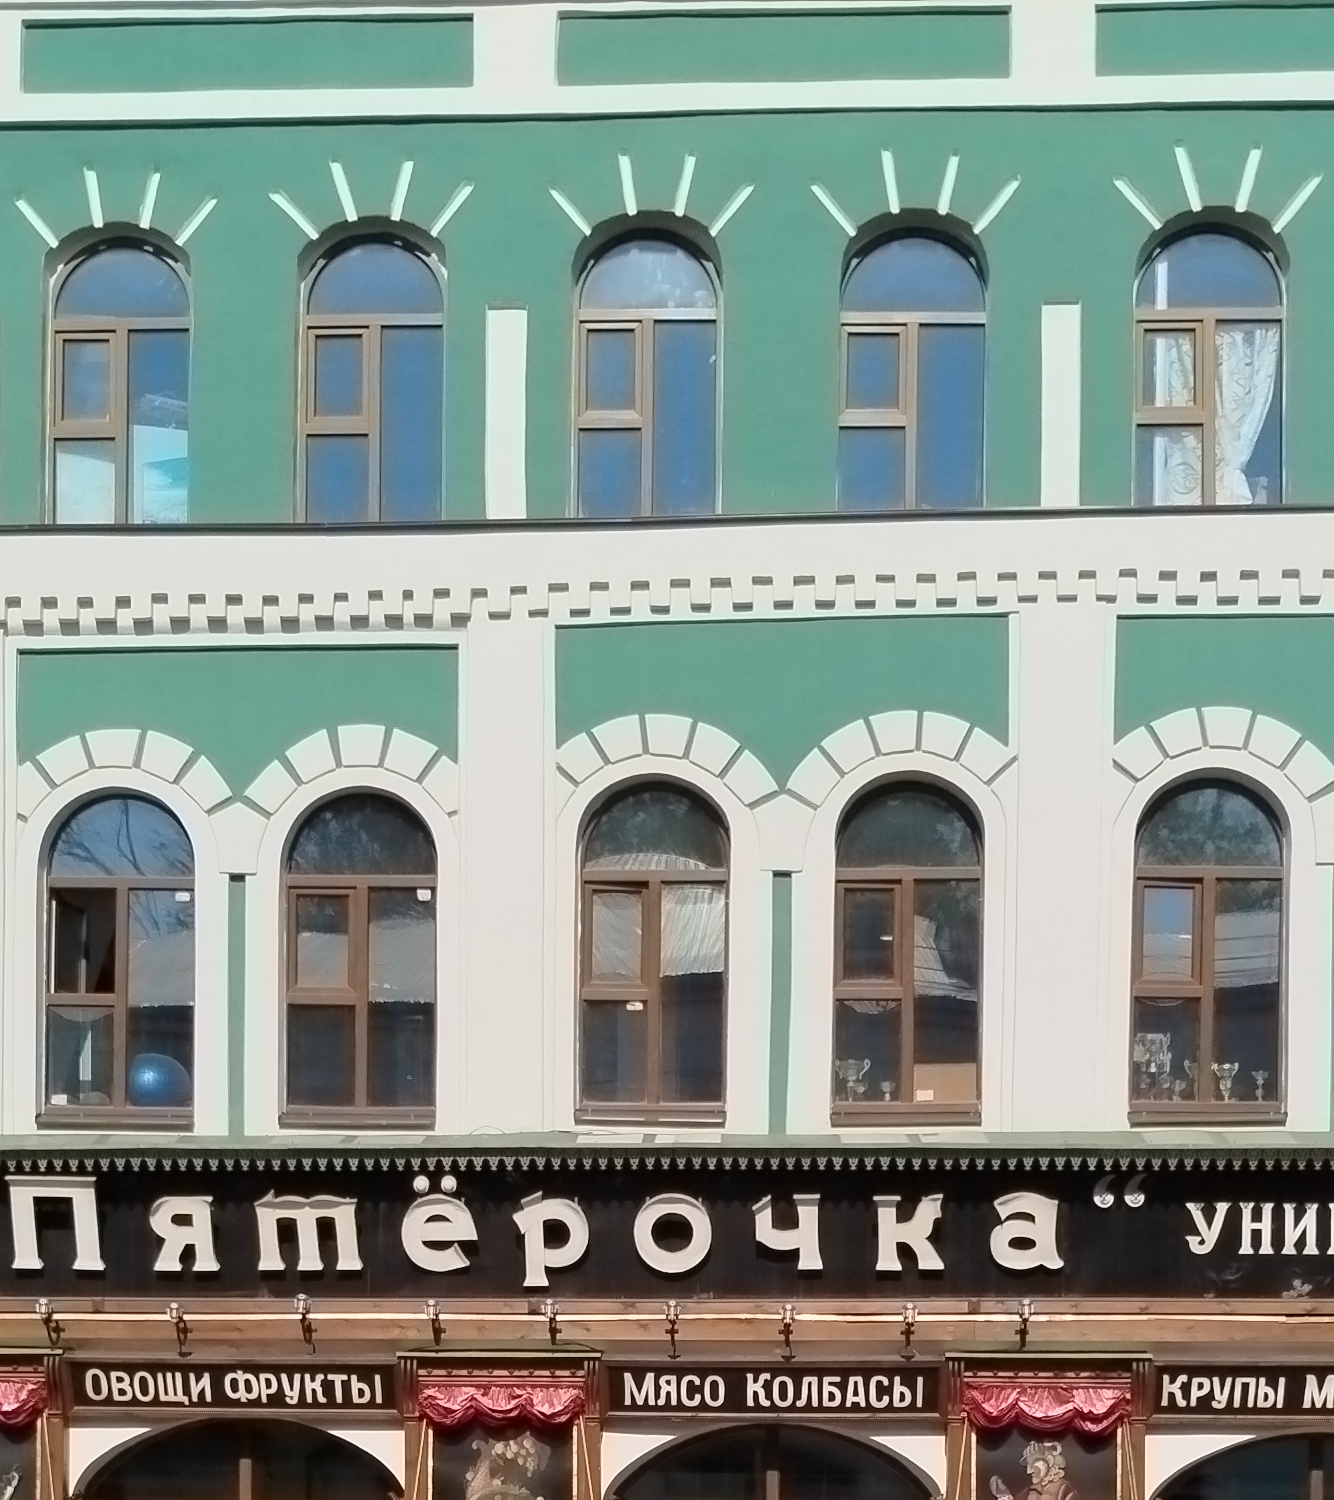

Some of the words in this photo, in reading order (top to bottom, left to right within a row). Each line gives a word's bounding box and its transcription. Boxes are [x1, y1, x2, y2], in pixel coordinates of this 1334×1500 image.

[85, 1368, 212, 1406] ОВОЩИ
[224, 1369, 383, 1405] ФРУКТЫ
[623, 1372, 726, 1408] МЯСО
[745, 1372, 924, 1409] КОЛБАСЫ
[1160, 1374, 1286, 1410] КРУПЫ
